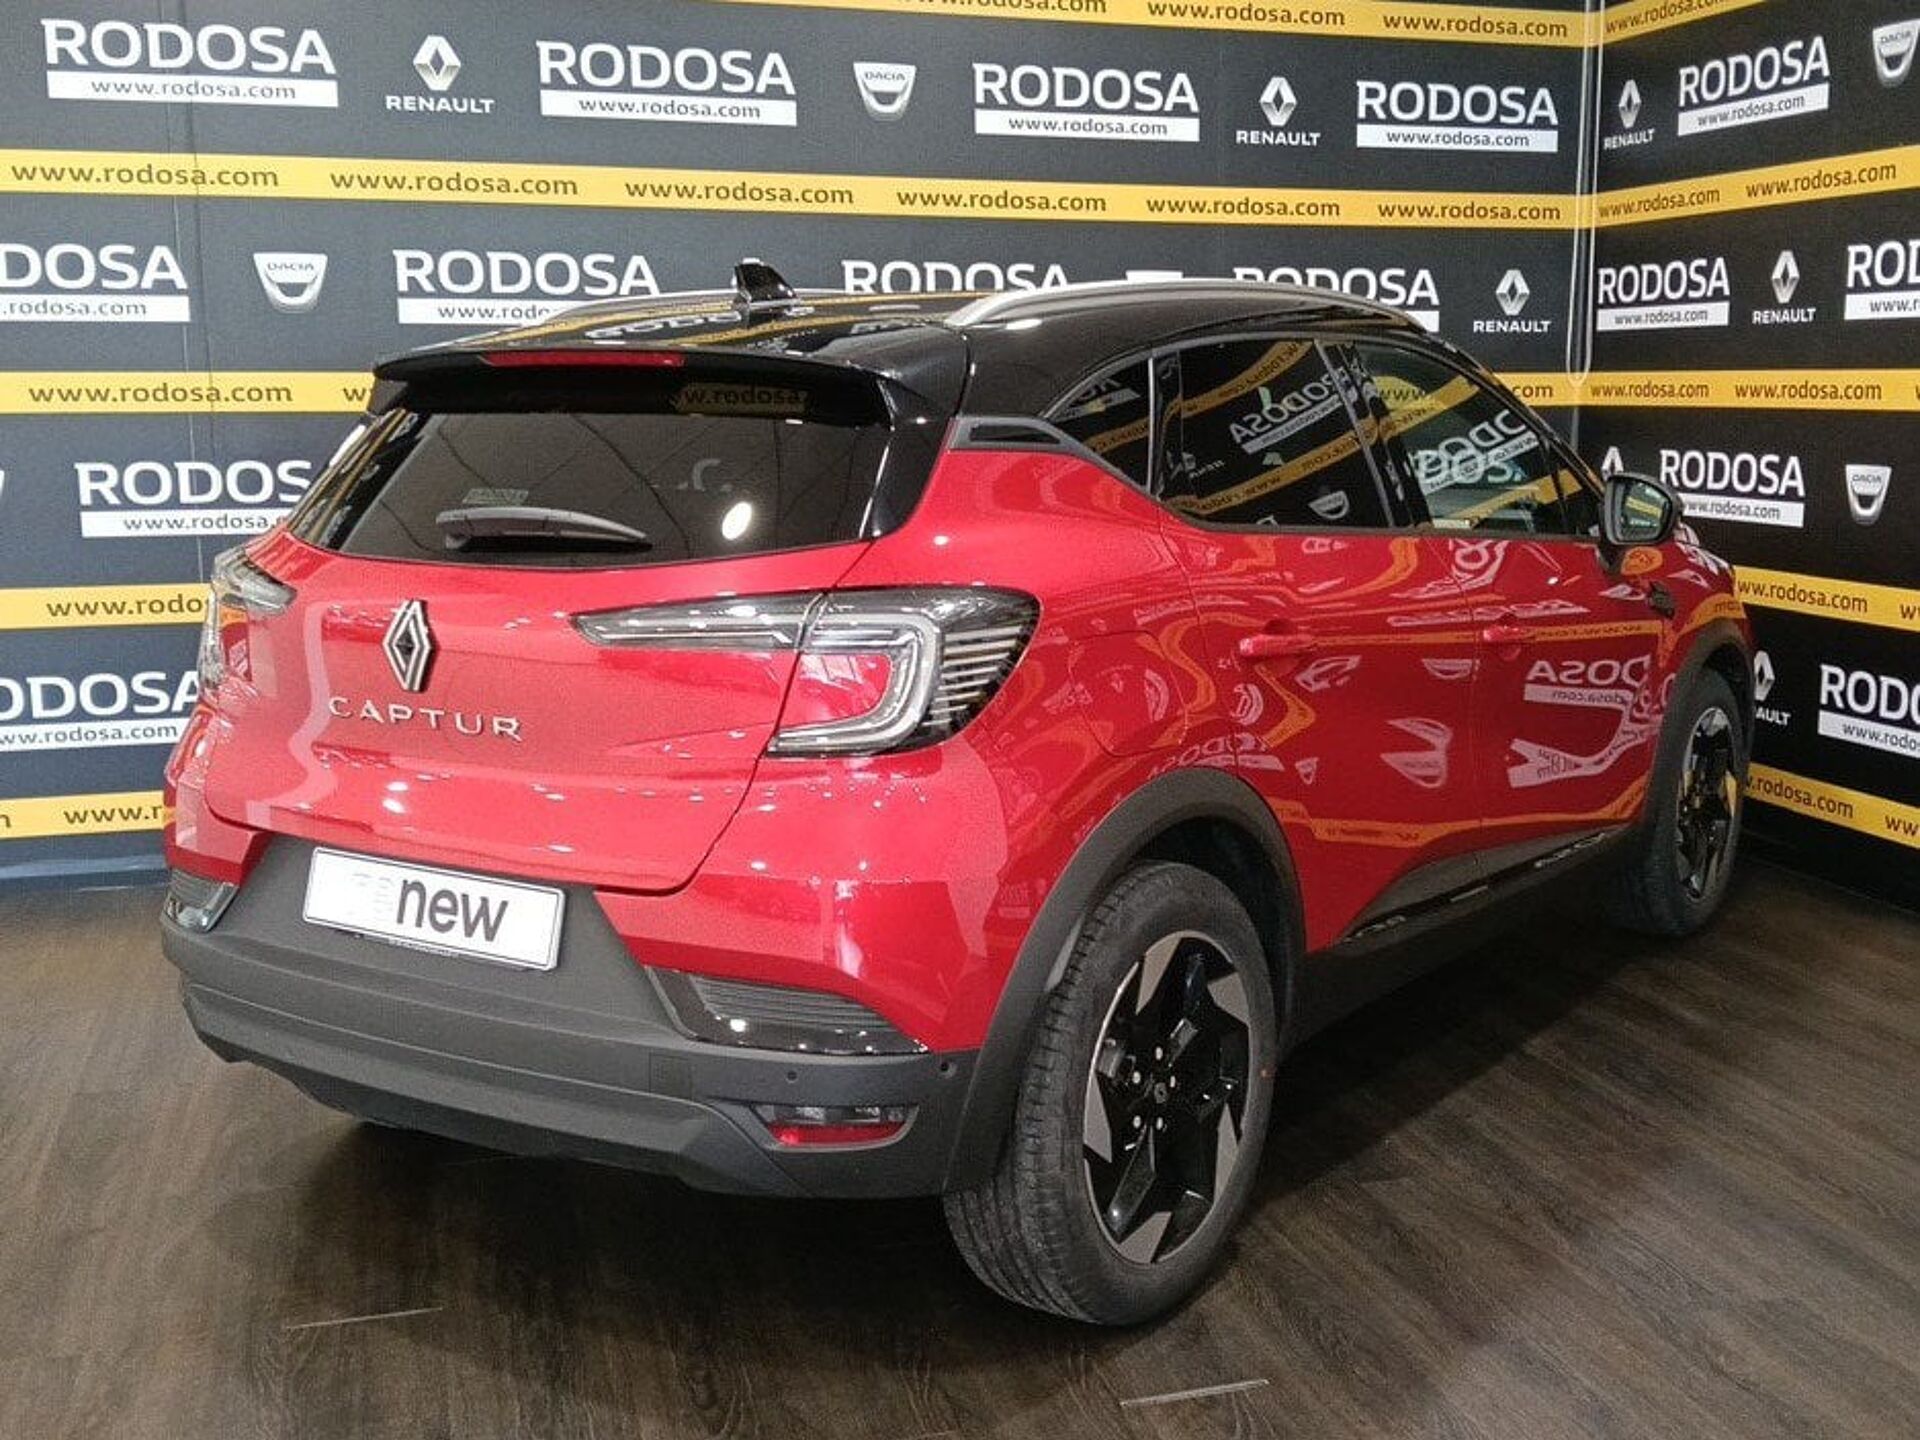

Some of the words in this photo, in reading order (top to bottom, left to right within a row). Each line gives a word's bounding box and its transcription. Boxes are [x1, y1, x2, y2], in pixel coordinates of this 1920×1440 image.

[1148, 2, 1345, 26] www.rodosa.com
[1383, 12, 1568, 38] www.rodosa.com
[41, 18, 336, 74] RODOSA
[536, 40, 796, 94] RODOSA
[864, 71, 906, 82] DACIA
[1679, 35, 1830, 107] RODOSA
[91, 79, 297, 100] www.rodosa.com
[973, 62, 1199, 112] RODOSA
[386, 95, 495, 113] RENAULT
[579, 98, 761, 119] www.rodosa.com
[1356, 80, 1558, 125] RODOSA
[1697, 94, 1806, 128] www.rodosa.com
[1008, 116, 1168, 136] www.rodosa.com
[1236, 130, 1320, 147] RENAULT
[1387, 129, 1530, 148] www.rodosa.com
[1603, 129, 1655, 150] RENAULT
[11, 163, 279, 189] www.rodosa.com
[331, 170, 579, 196] www.rodosa.com
[1746, 161, 1897, 200] www.rodosa.com
[625, 179, 855, 205] www.rodosa.com
[897, 187, 1108, 213] www.rodosa.com
[1600, 187, 1721, 220] www.rodosa.com
[1147, 196, 1341, 219] www.rodosa.com
[1378, 203, 1561, 222] www.rodosa.com
[393, 250, 660, 296] RODOSA
[1597, 256, 1730, 304] RODOSA
[1473, 321, 1551, 333] RENAULT
[1614, 309, 1709, 326] www.rodosa.com
[1752, 307, 1816, 324] RENAULT
[29, 379, 293, 402] www.rodosa.com
[1590, 380, 1709, 399] www.rodosa.com
[1735, 379, 1882, 400] www.rodosa.com
[1660, 449, 1806, 497] RODOSA
[329, 697, 522, 741] CAPTUR
[397, 879, 508, 942] new
